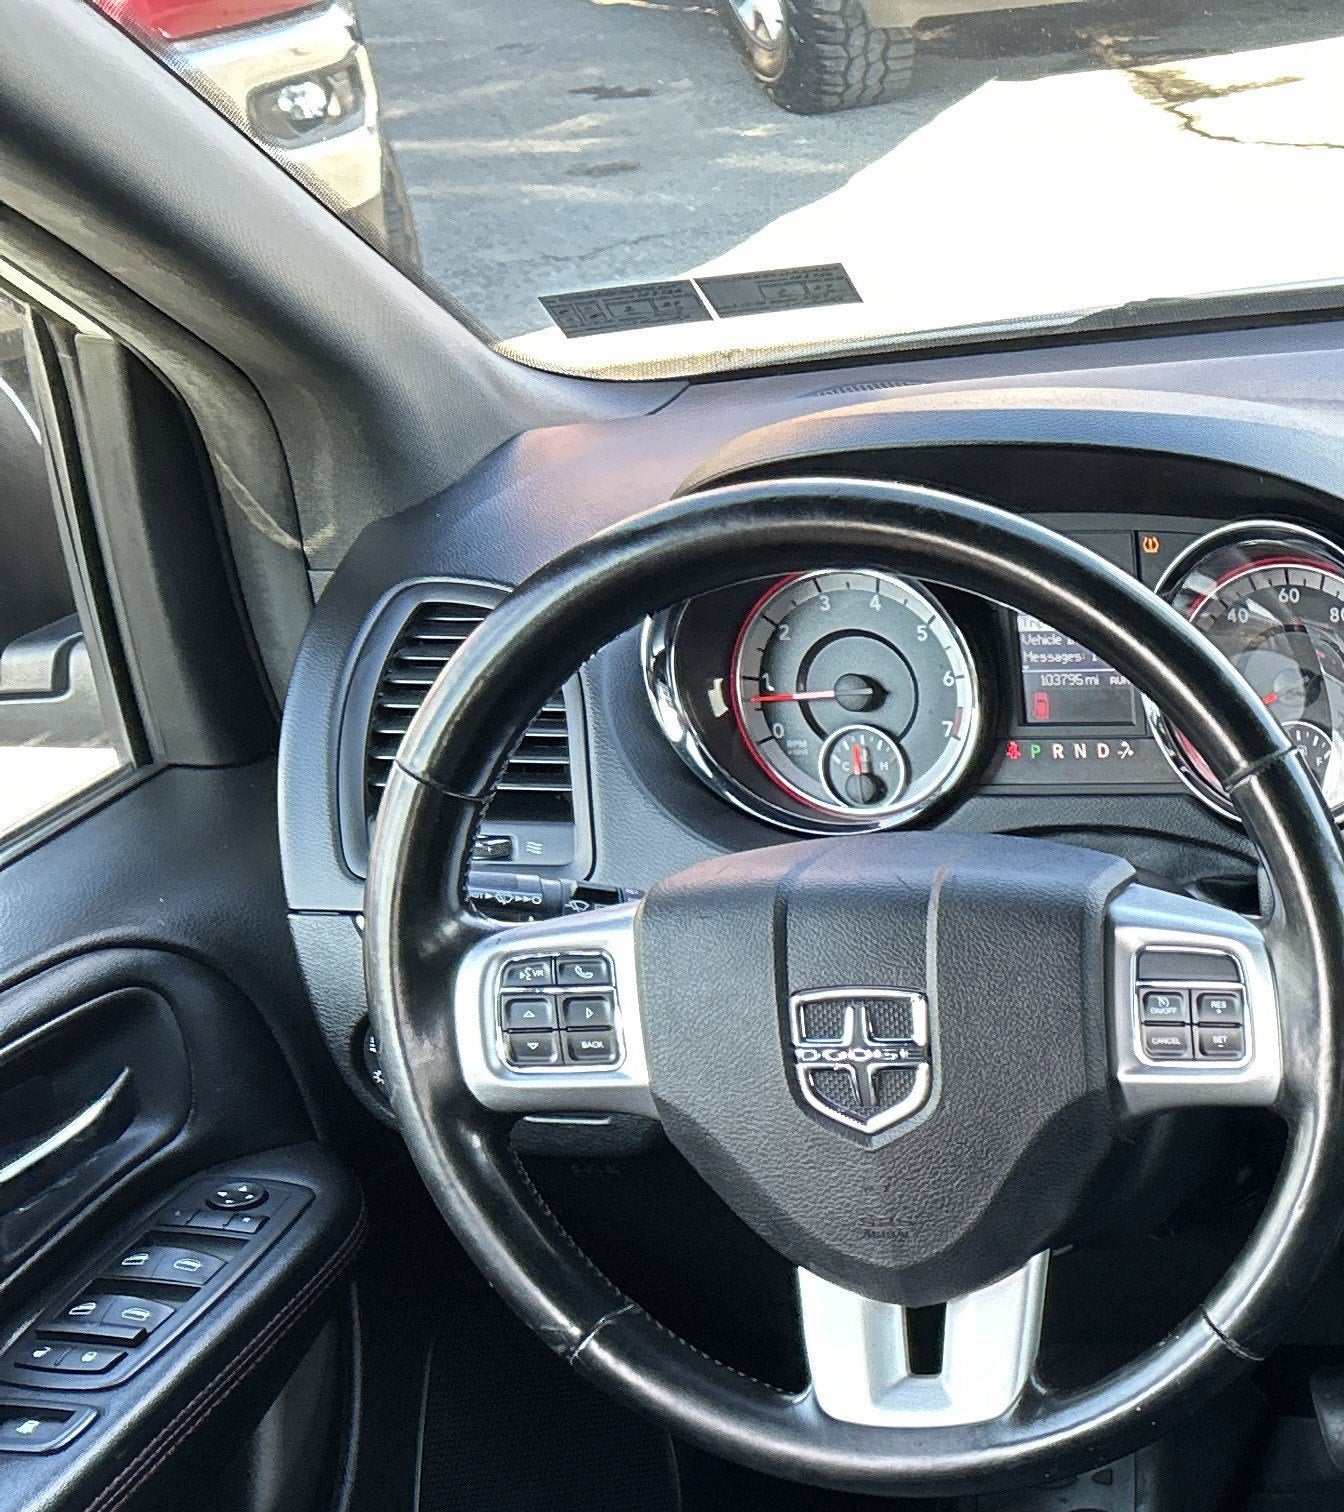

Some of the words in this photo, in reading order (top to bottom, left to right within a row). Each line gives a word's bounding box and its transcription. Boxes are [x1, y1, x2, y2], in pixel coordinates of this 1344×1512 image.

[870, 596, 882, 611] 4
[1278, 588, 1300, 604] 60
[820, 597, 831, 611] 3
[1227, 608, 1250, 624] 40
[778, 626, 791, 641] 2
[917, 627, 928, 641] 5
[762, 673, 774, 691] 1
[942, 671, 955, 686] 6
[773, 723, 785, 739] 0
[942, 721, 953, 736] 7
[1030, 744, 1041, 760] P
[1053, 744, 1065, 760] R
[1074, 743, 1087, 758] N
[1098, 743, 1110, 758] D
[582, 1041, 604, 1050] BACK
[1213, 1036, 1228, 1044] SET
